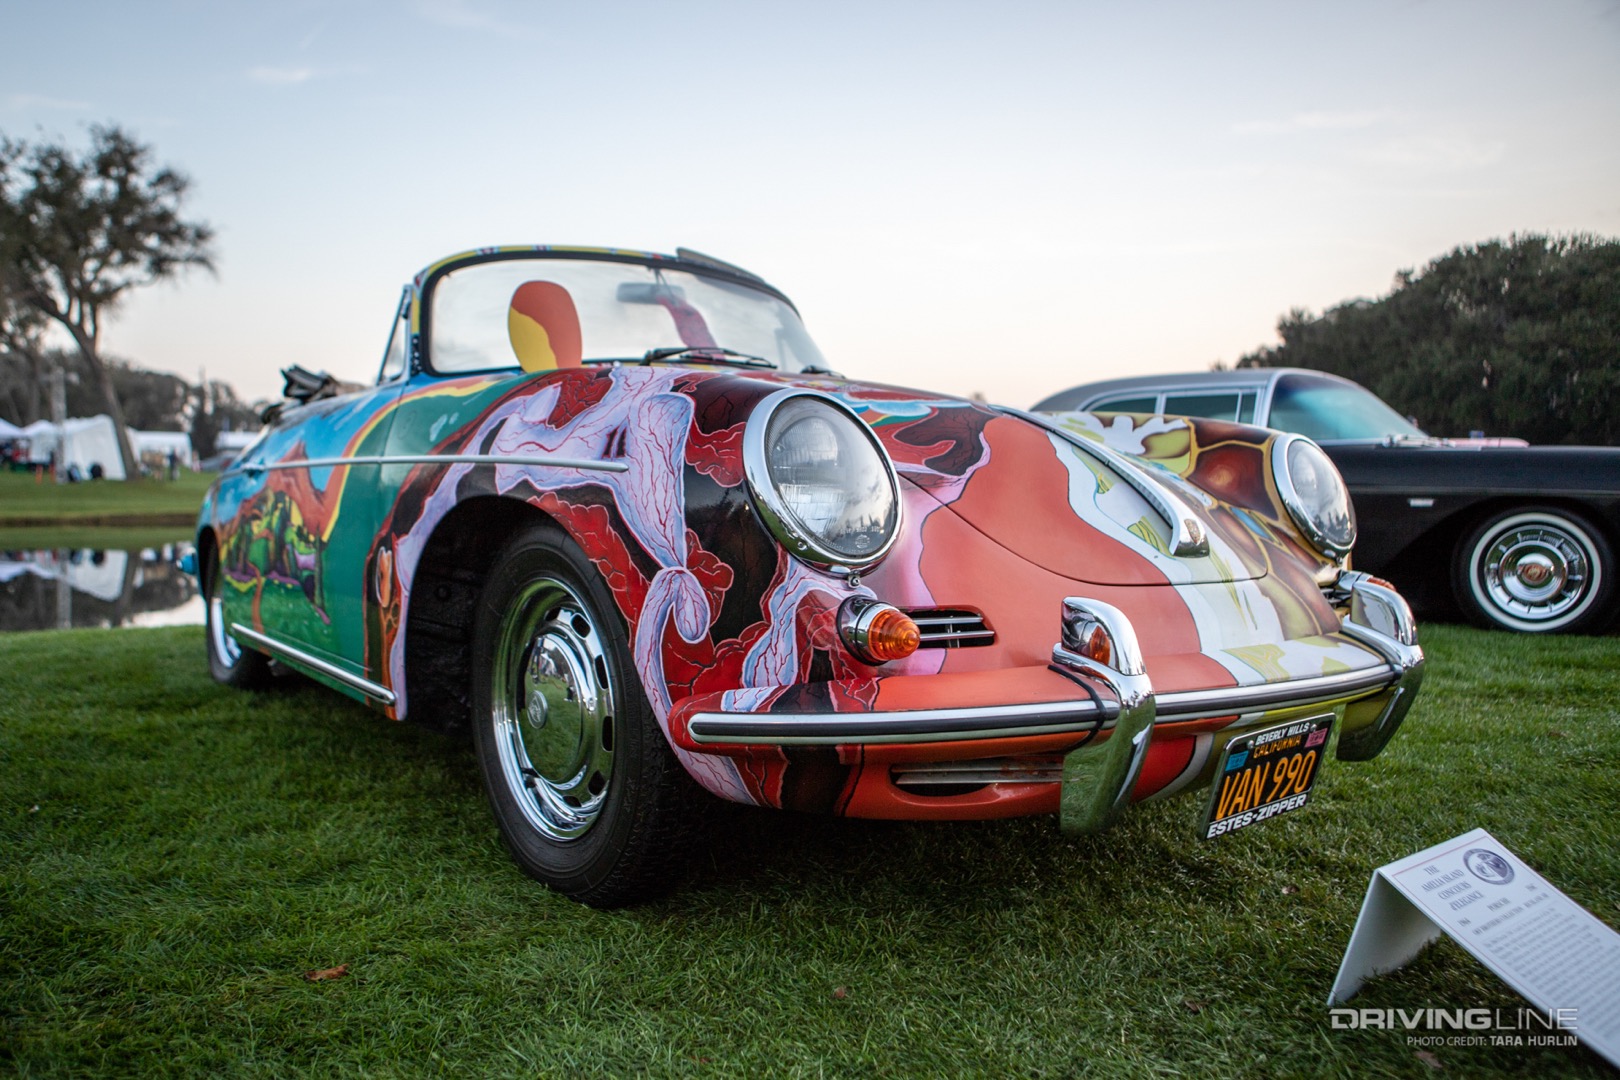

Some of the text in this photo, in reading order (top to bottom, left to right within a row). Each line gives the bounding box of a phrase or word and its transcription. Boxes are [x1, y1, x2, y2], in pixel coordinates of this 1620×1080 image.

[1255, 722, 1309, 745] BEVERLY HILLS
[1253, 735, 1301, 758] CALIFORNIA
[1216, 750, 1316, 821] VAN 990
[1207, 794, 1307, 838] ESTES-ZIPPER
[1421, 869, 1464, 893] AMELIA ISLAND
[1423, 865, 1439, 875] THE
[1437, 881, 1472, 900] CONCOURS
